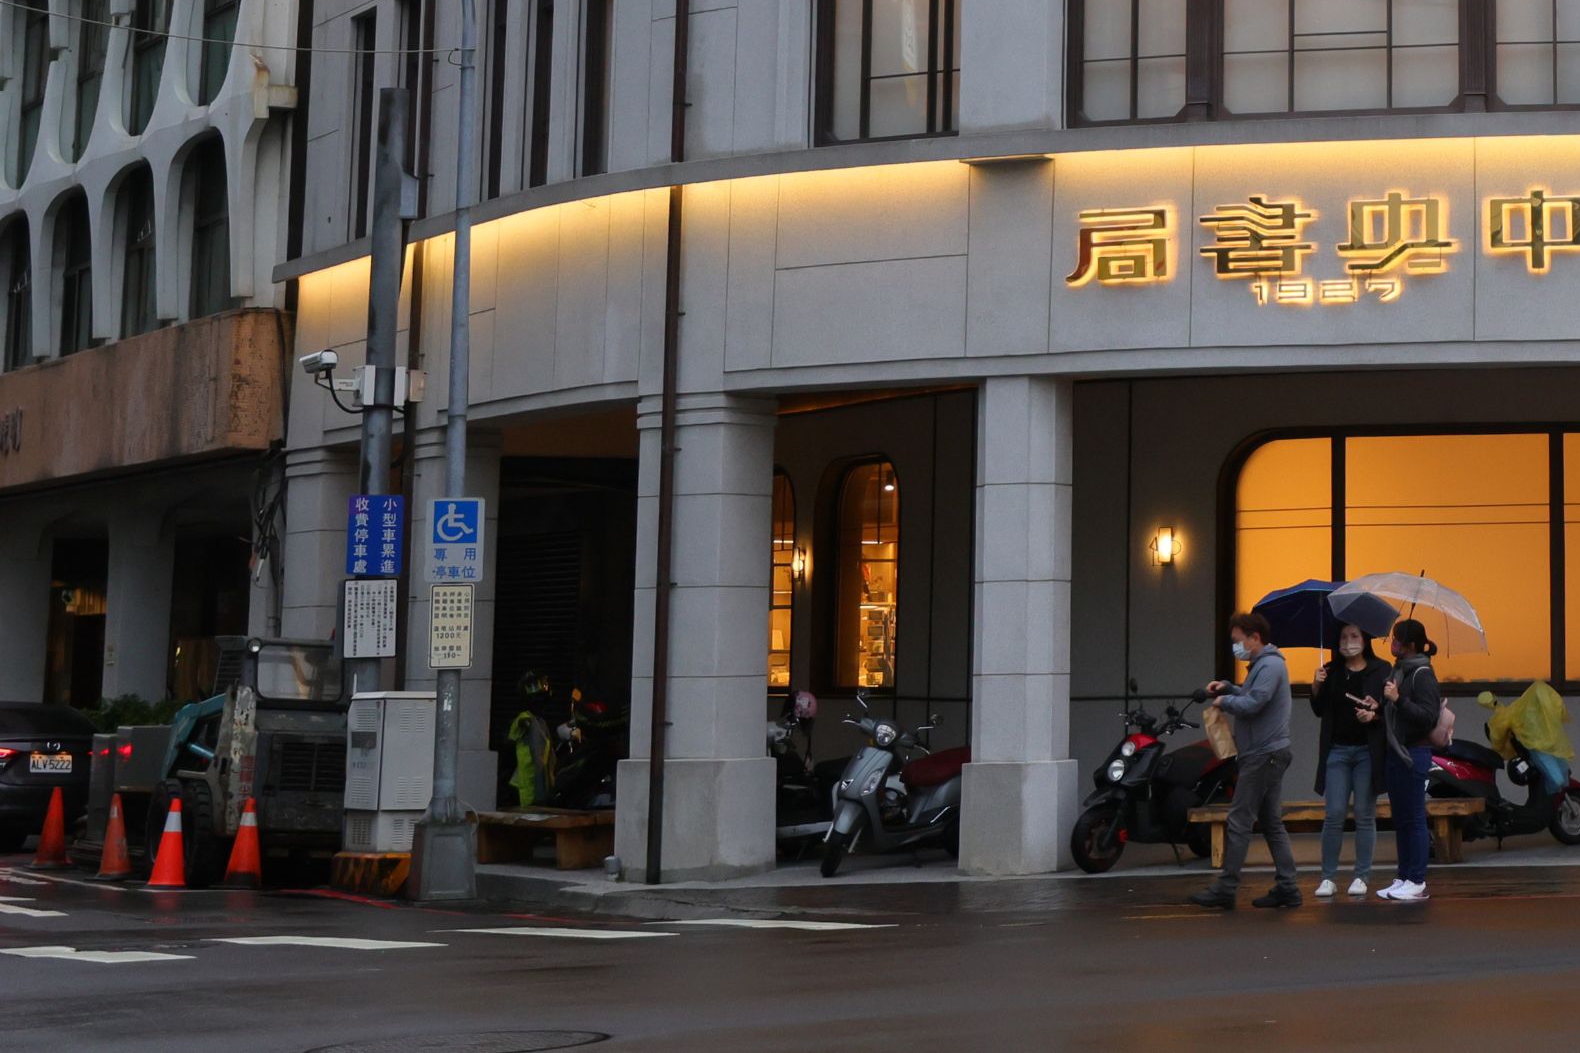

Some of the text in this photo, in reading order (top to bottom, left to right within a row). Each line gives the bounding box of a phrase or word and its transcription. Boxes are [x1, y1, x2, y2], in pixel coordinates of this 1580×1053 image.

[1252, 279, 1400, 304] 1927
[353, 498, 370, 573] 收費停車處
[380, 498, 398, 573] 小型車累進
[434, 566, 476, 579] 停車位
